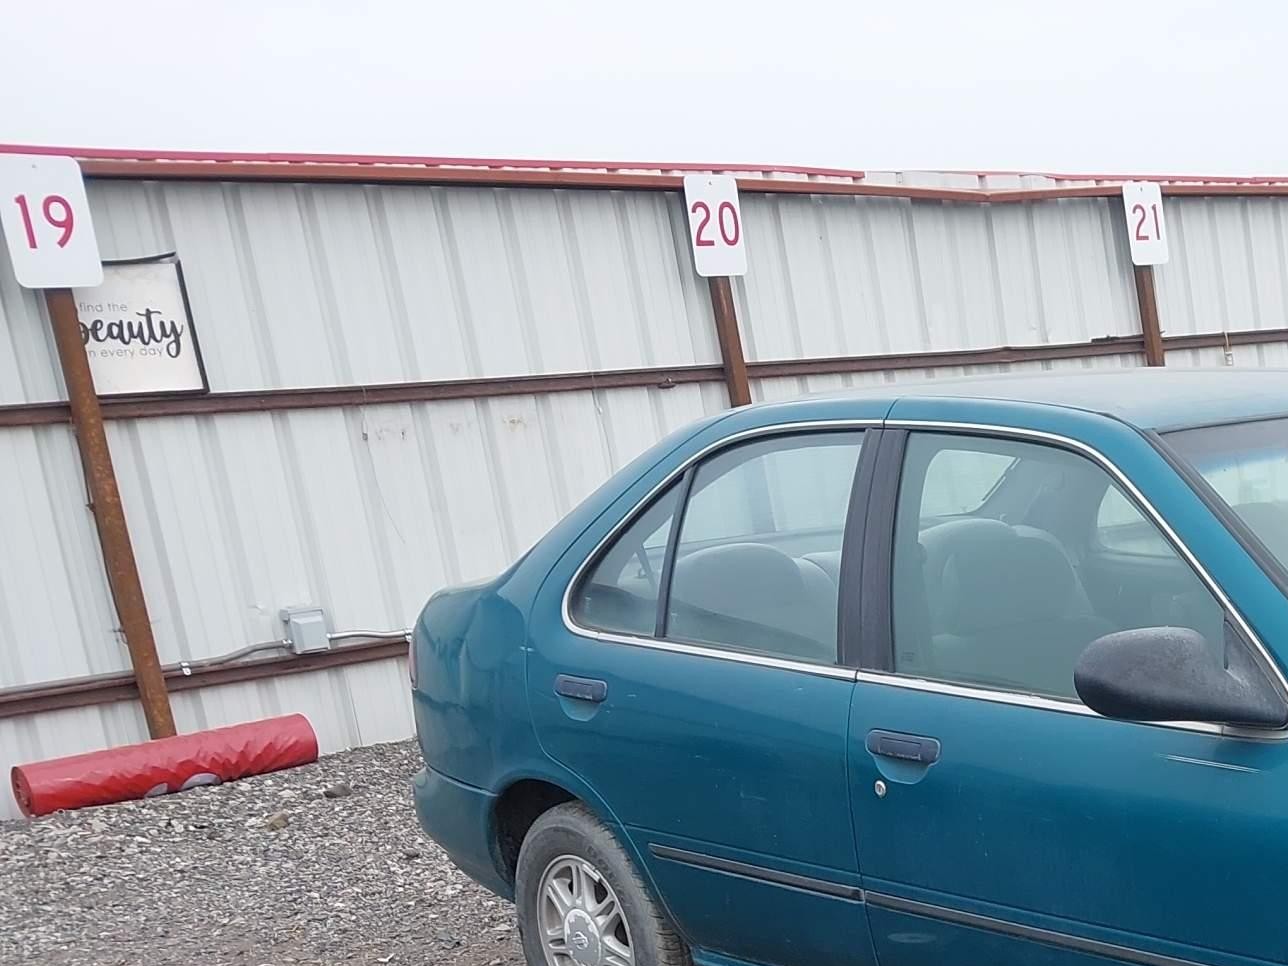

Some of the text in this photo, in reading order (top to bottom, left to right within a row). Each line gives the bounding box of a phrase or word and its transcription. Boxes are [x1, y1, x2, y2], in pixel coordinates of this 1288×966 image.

[15, 194, 74, 249] 19
[691, 200, 740, 247] 20
[1132, 202, 1161, 242] 21
[107, 302, 128, 313] the
[100, 347, 135, 359] every
[139, 346, 164, 358] day
